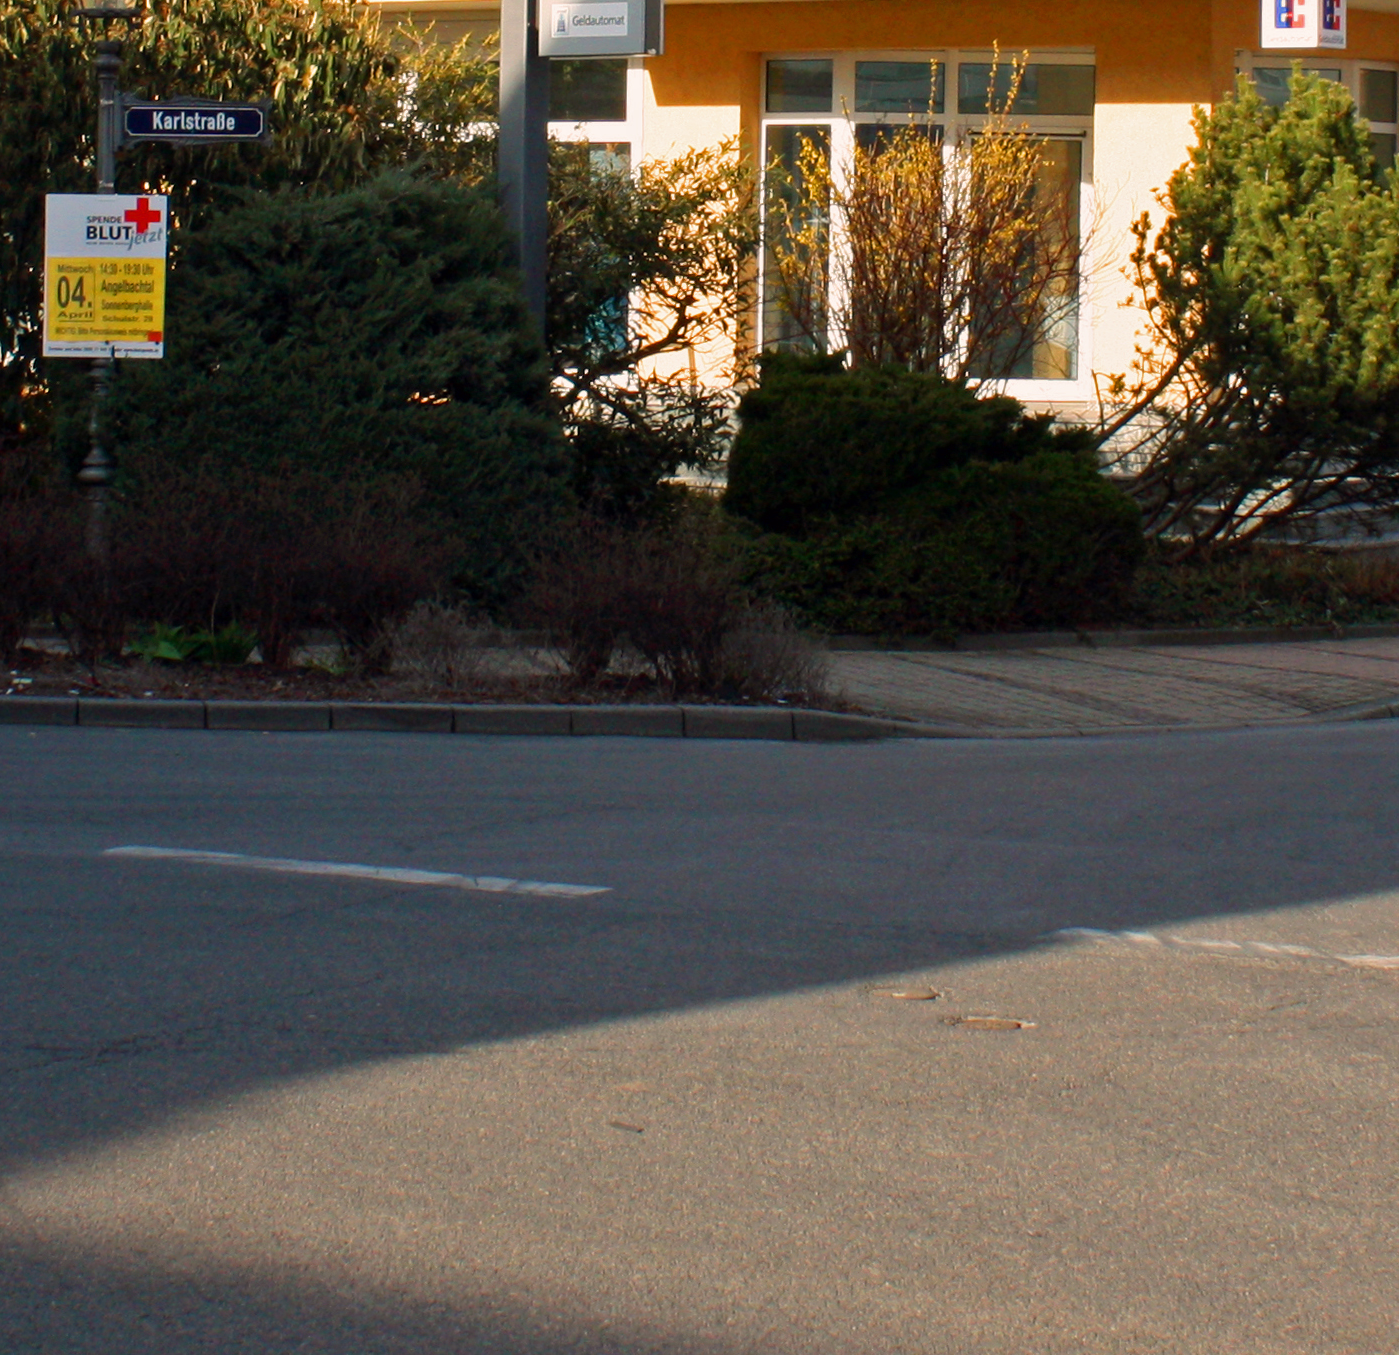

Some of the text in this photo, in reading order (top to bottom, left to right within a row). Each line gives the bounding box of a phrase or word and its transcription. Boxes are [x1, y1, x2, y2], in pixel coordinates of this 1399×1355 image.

[572, 15, 625, 27] Geldautomat
[152, 111, 236, 131] Karlstraße
[86, 216, 122, 224] SPENDE
[86, 226, 132, 240] BLUT
[127, 227, 163, 251] jetzt
[57, 264, 93, 273] Mittwoch
[57, 275, 92, 308] 04.
[57, 310, 93, 319] April
